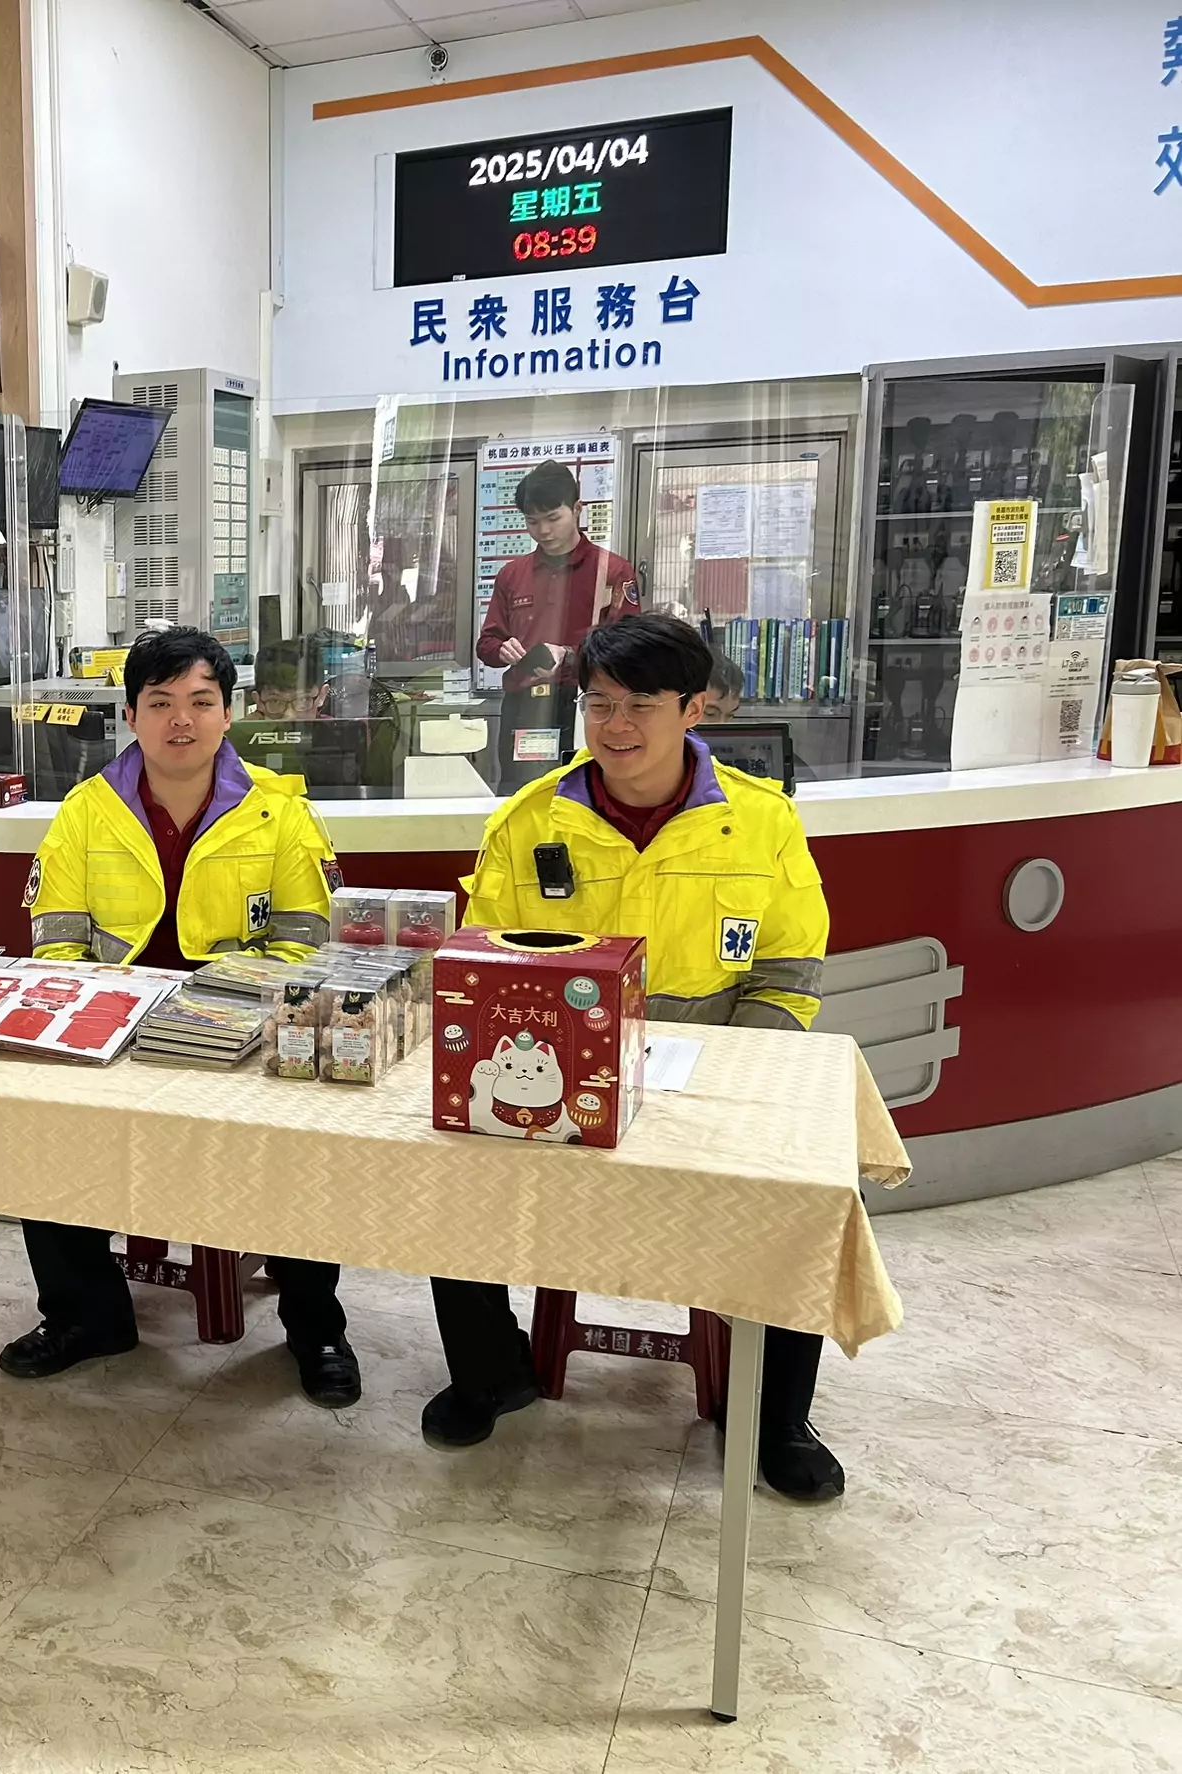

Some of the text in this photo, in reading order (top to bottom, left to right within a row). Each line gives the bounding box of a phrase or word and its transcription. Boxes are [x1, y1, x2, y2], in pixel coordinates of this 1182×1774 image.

[469, 134, 649, 186] 2025/04/04
[509, 181, 602, 222] 星期五
[513, 224, 598, 261] 08:39
[443, 339, 662, 381] Information
[248, 731, 302, 745] ASUS
[490, 1003, 559, 1028] 大吉大利
[584, 1328, 682, 1361] 桃園義消
